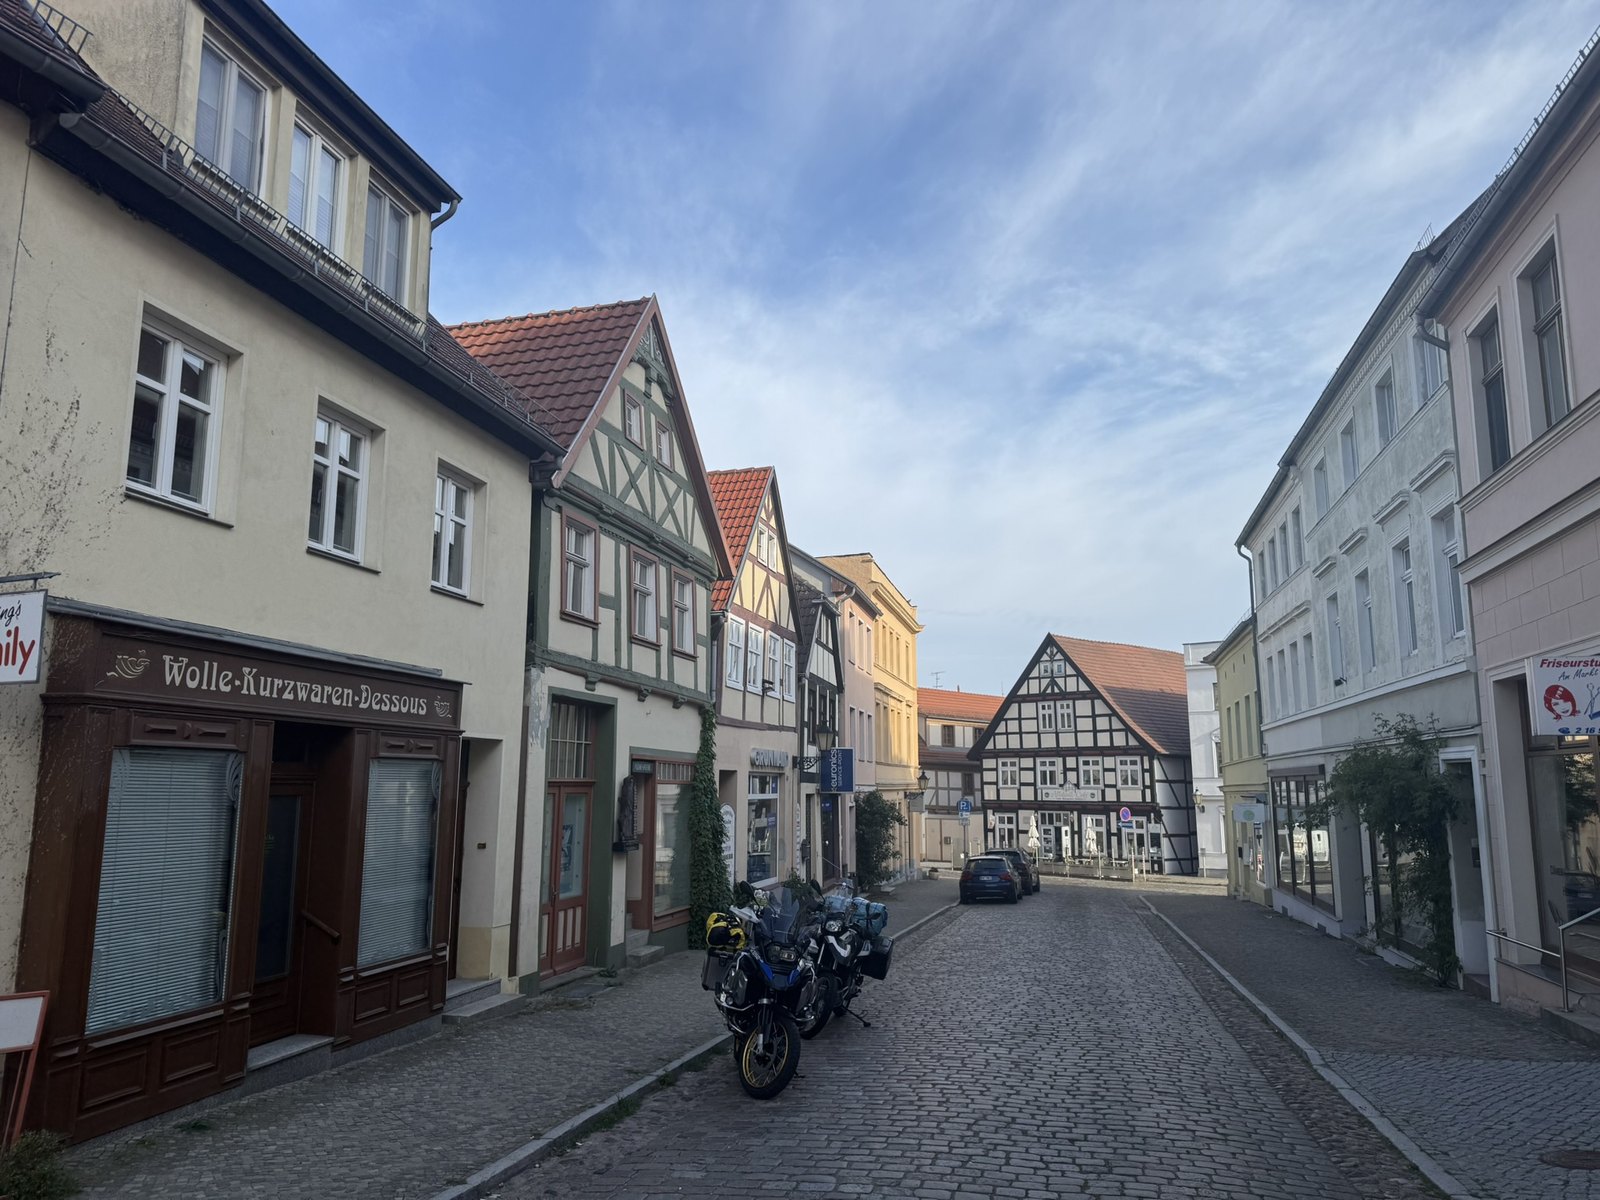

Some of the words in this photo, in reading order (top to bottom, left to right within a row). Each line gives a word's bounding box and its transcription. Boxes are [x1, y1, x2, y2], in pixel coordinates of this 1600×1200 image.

[0, 626, 36, 675] ily
[1558, 671, 1570, 681] Am
[1573, 668, 1599, 680] Markt
[829, 749, 838, 787] euronics
